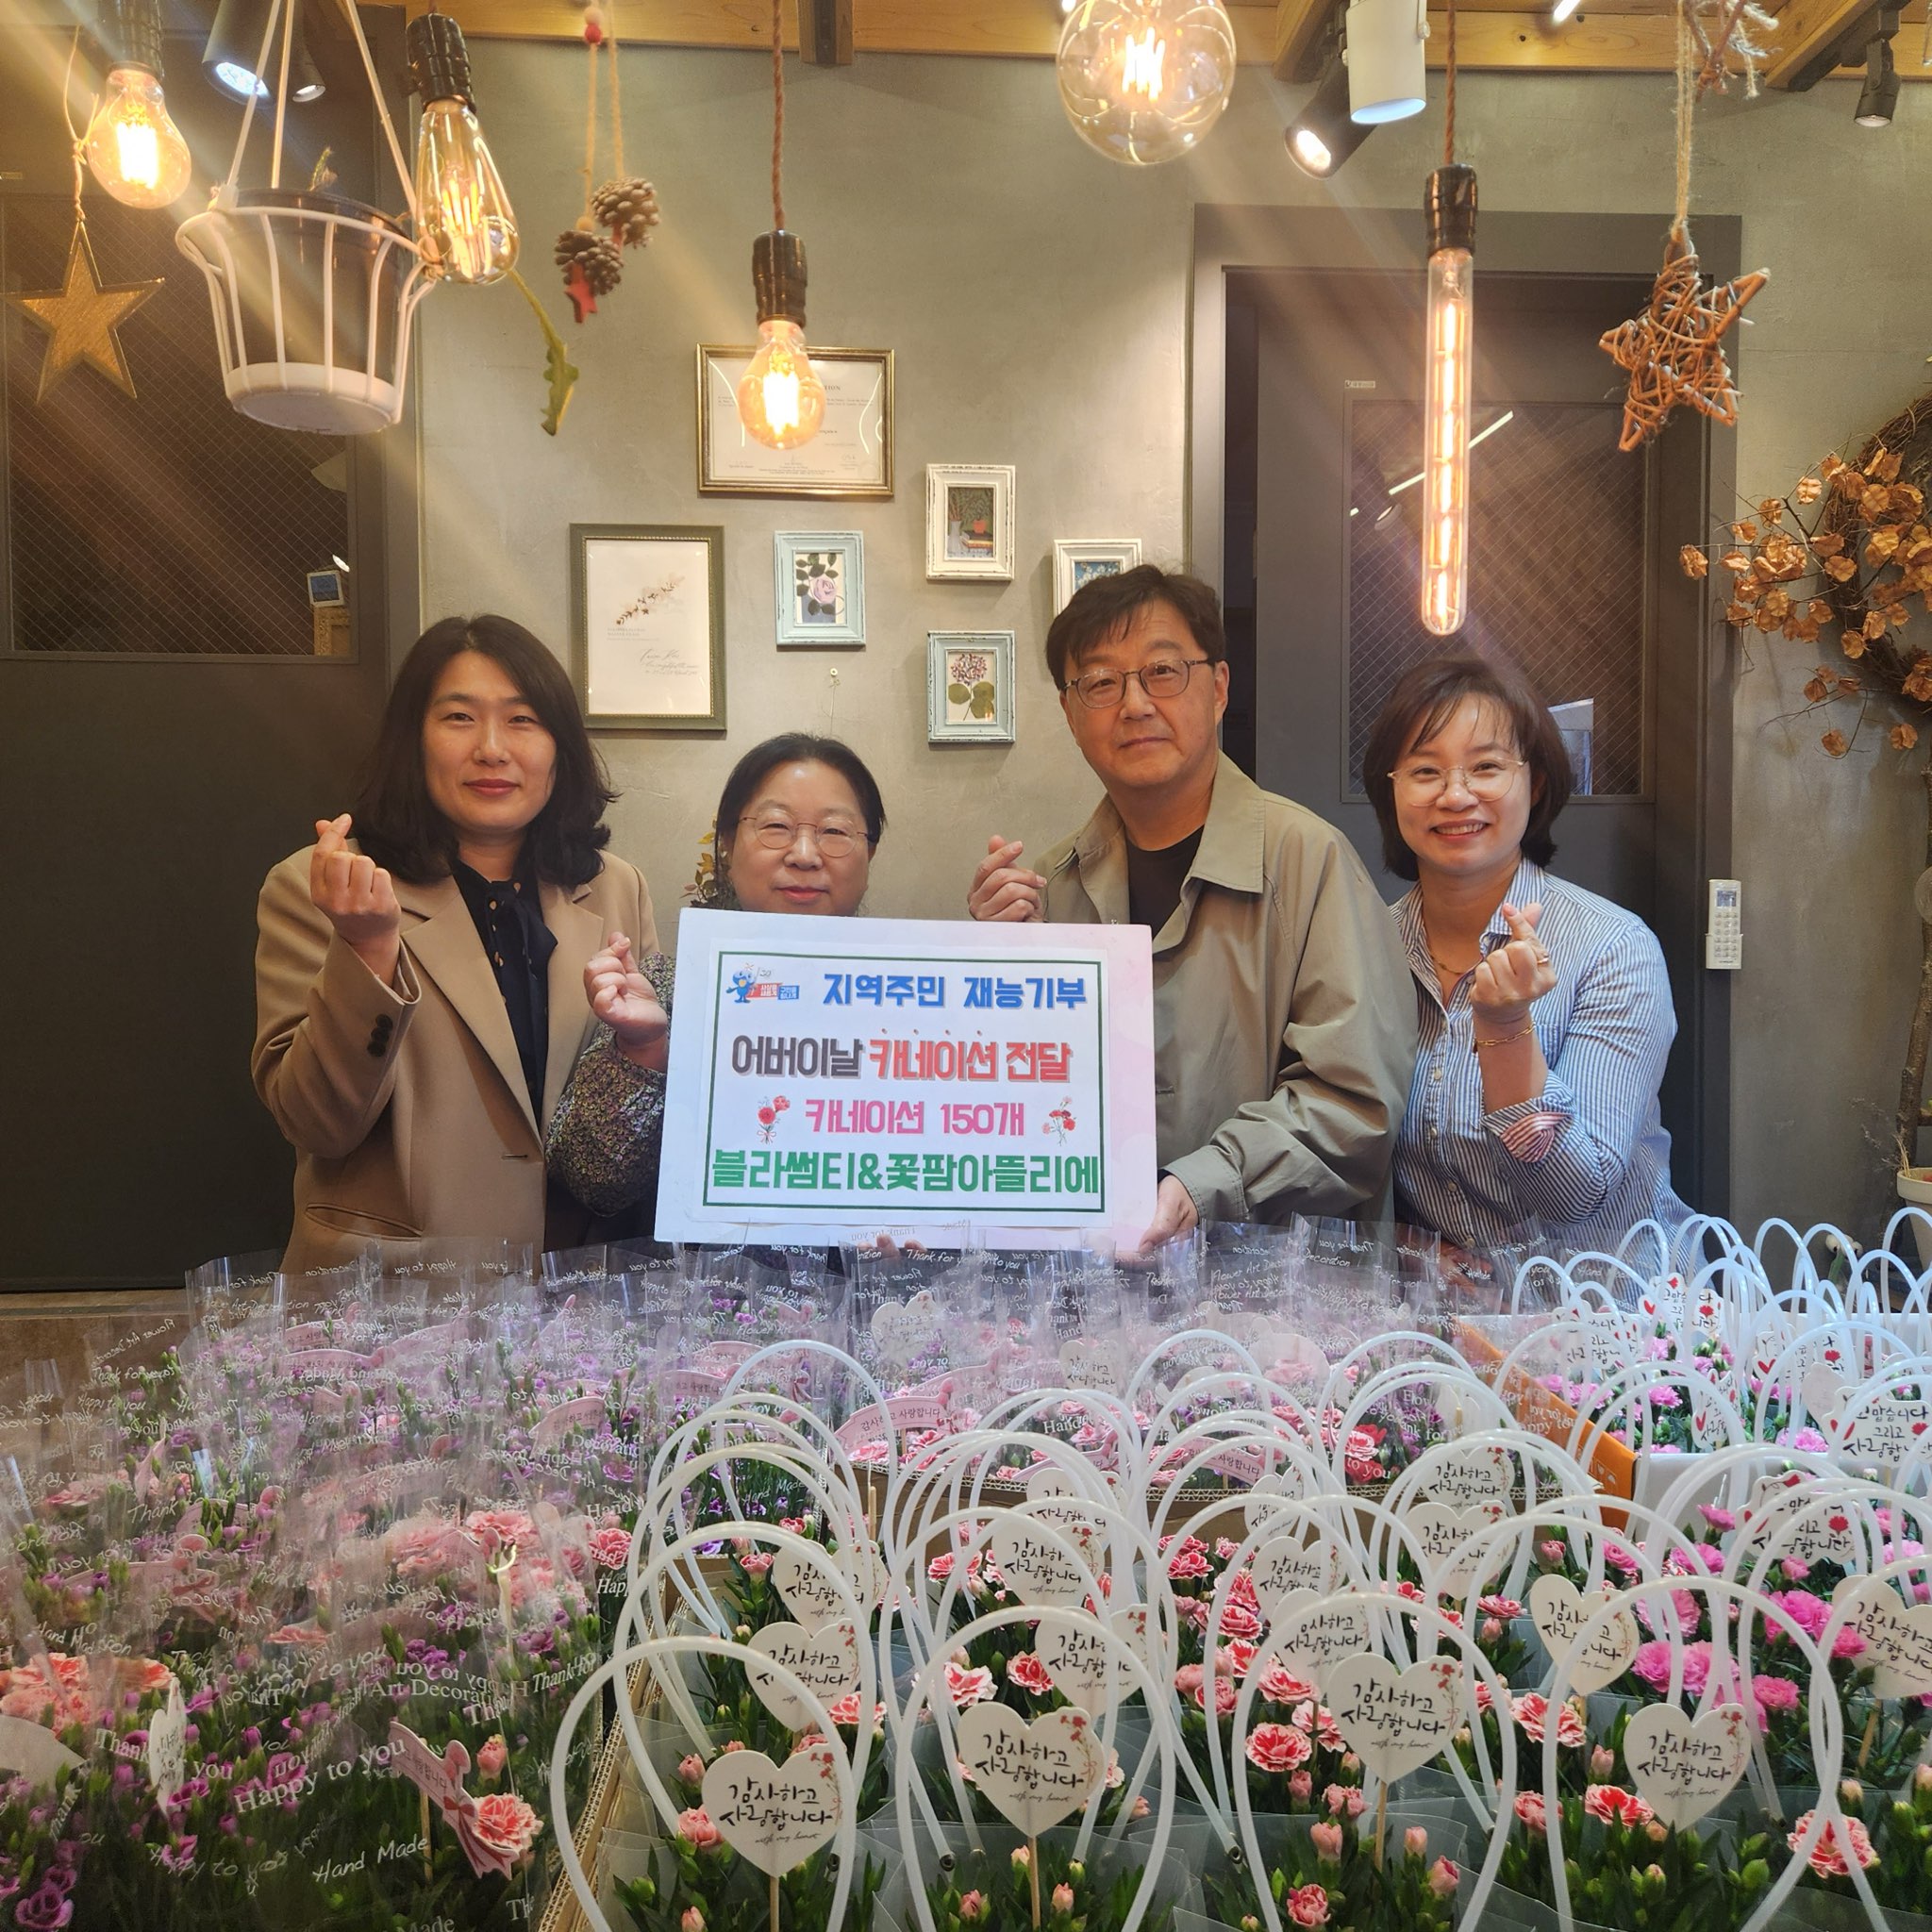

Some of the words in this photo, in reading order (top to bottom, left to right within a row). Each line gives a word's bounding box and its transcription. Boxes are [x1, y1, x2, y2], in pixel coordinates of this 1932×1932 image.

[823, 974, 945, 1008] 지역주민
[964, 976, 1087, 1009] 재능기부
[732, 1035, 863, 1079] 어버이날
[869, 1040, 998, 1081] 카네이션
[1006, 1041, 1073, 1083] 전달
[806, 1099, 924, 1137] 카네이션
[941, 1103, 1025, 1138] 150개
[712, 1148, 1100, 1193] 블라썸티&꽃팜아뜰리에
[907, 1249, 935, 1263] Thank
[938, 1252, 955, 1262] for
[1306, 1248, 1351, 1267] Decoration
[1576, 1265, 1603, 1277] Hand
[899, 1407, 941, 1419] 사랑합니다
[1873, 1426, 1906, 1439] 그리고
[1217, 1455, 1260, 1477] 사랑합니다
[1362, 1461, 1391, 1480] you
[1435, 1461, 1493, 1482] 감사하고
[743, 1488, 770, 1504] Hand
[1428, 1481, 1501, 1500] 사랑합니다
[127, 1501, 179, 1524] Thank
[1012, 1538, 1074, 1566] 감사하
[1548, 1599, 1614, 1641] 감사고
[348, 1643, 388, 1671] you
[769, 1644, 841, 1669] 감사하고
[1284, 1633, 1364, 1656] 사랑합니다
[371, 1679, 405, 1697] Art
[532, 1670, 573, 1694] Thank
[1353, 1677, 1436, 1714] 감사하고
[1341, 1705, 1446, 1737] 사랑합니다
[94, 1727, 151, 1762] Thank
[192, 1760, 234, 1781] you
[983, 1728, 1072, 1768] 감사하고
[1648, 1728, 1724, 1761] 감사하고
[233, 1772, 318, 1813] Happy
[325, 1758, 353, 1781] to
[358, 1737, 408, 1780] you
[974, 1756, 1085, 1790] 사랑합니다
[1638, 1757, 1732, 1786] 사랑합니다
[728, 1776, 820, 1805] 감사하고
[719, 1804, 834, 1831] 사랑합니다
[212, 1857, 240, 1877] to
[312, 1850, 366, 1884] Hand
[376, 1833, 429, 1864] Made
